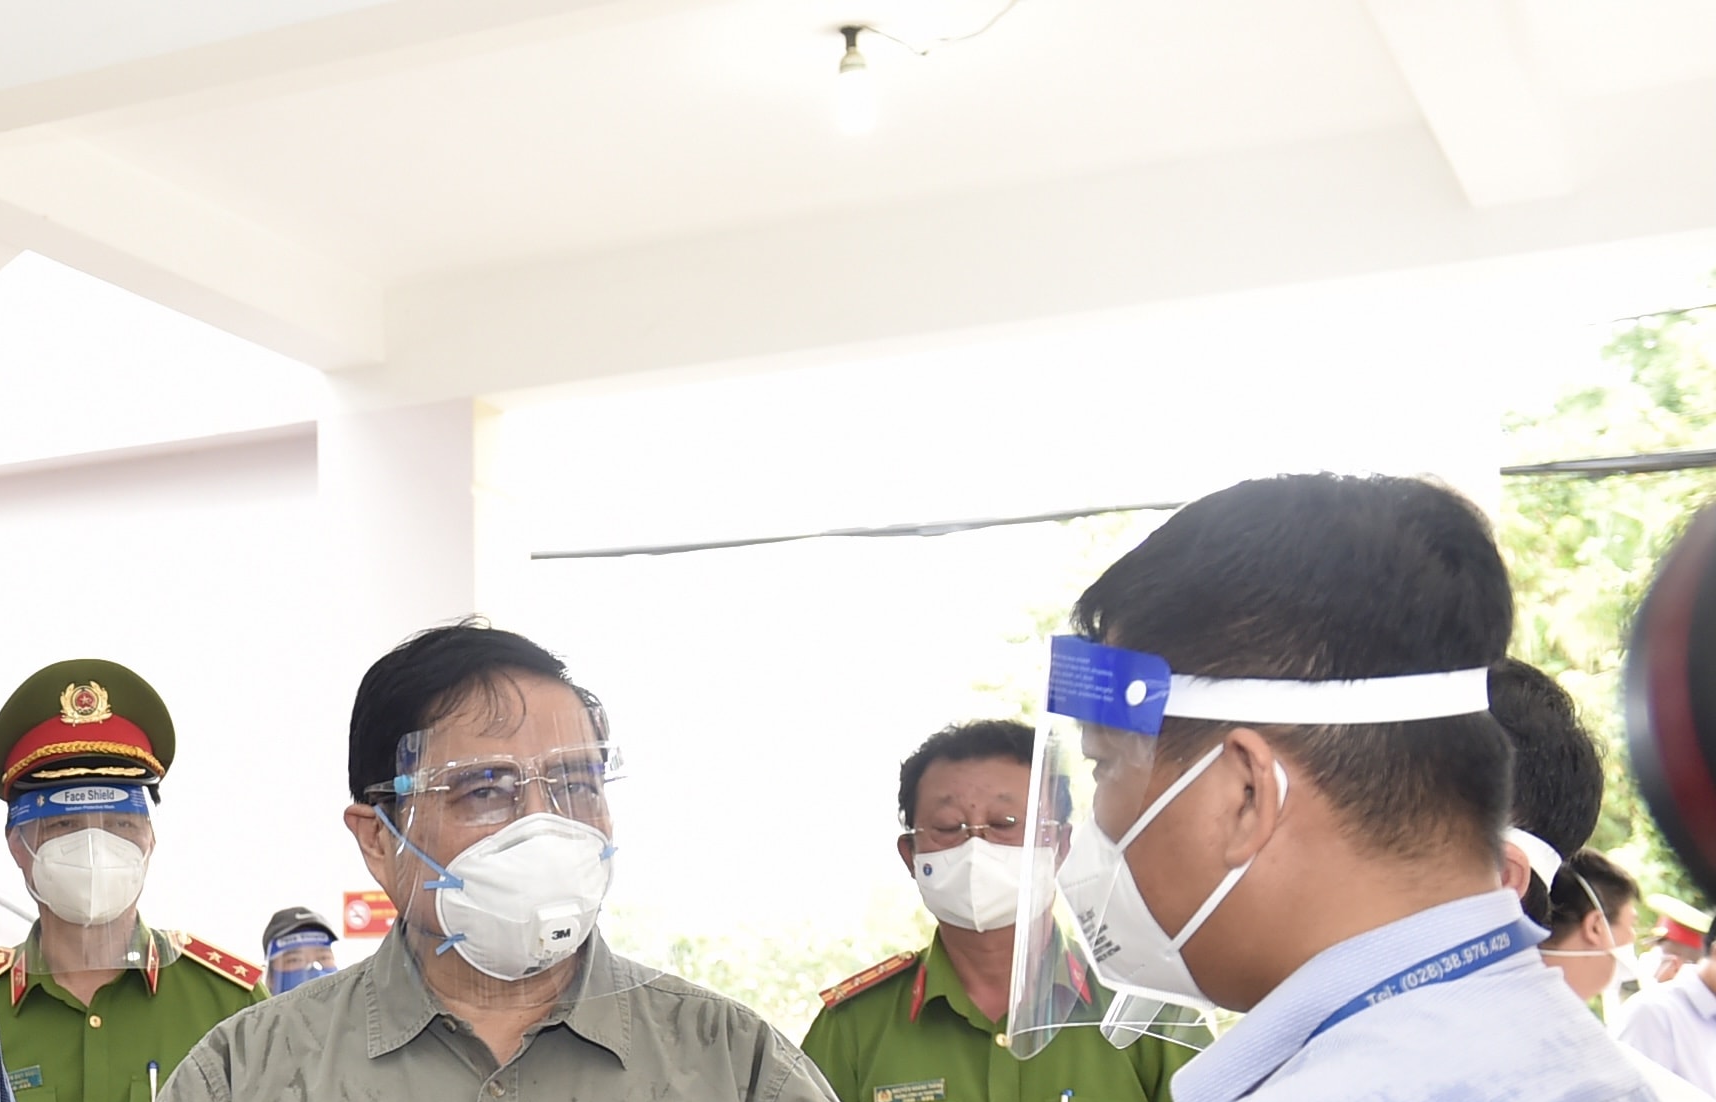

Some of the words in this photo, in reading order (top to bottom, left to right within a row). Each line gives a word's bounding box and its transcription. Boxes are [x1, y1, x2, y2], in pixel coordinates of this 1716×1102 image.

[65, 791, 85, 802] Face
[88, 789, 115, 800] Shield
[552, 928, 571, 940] 3M
